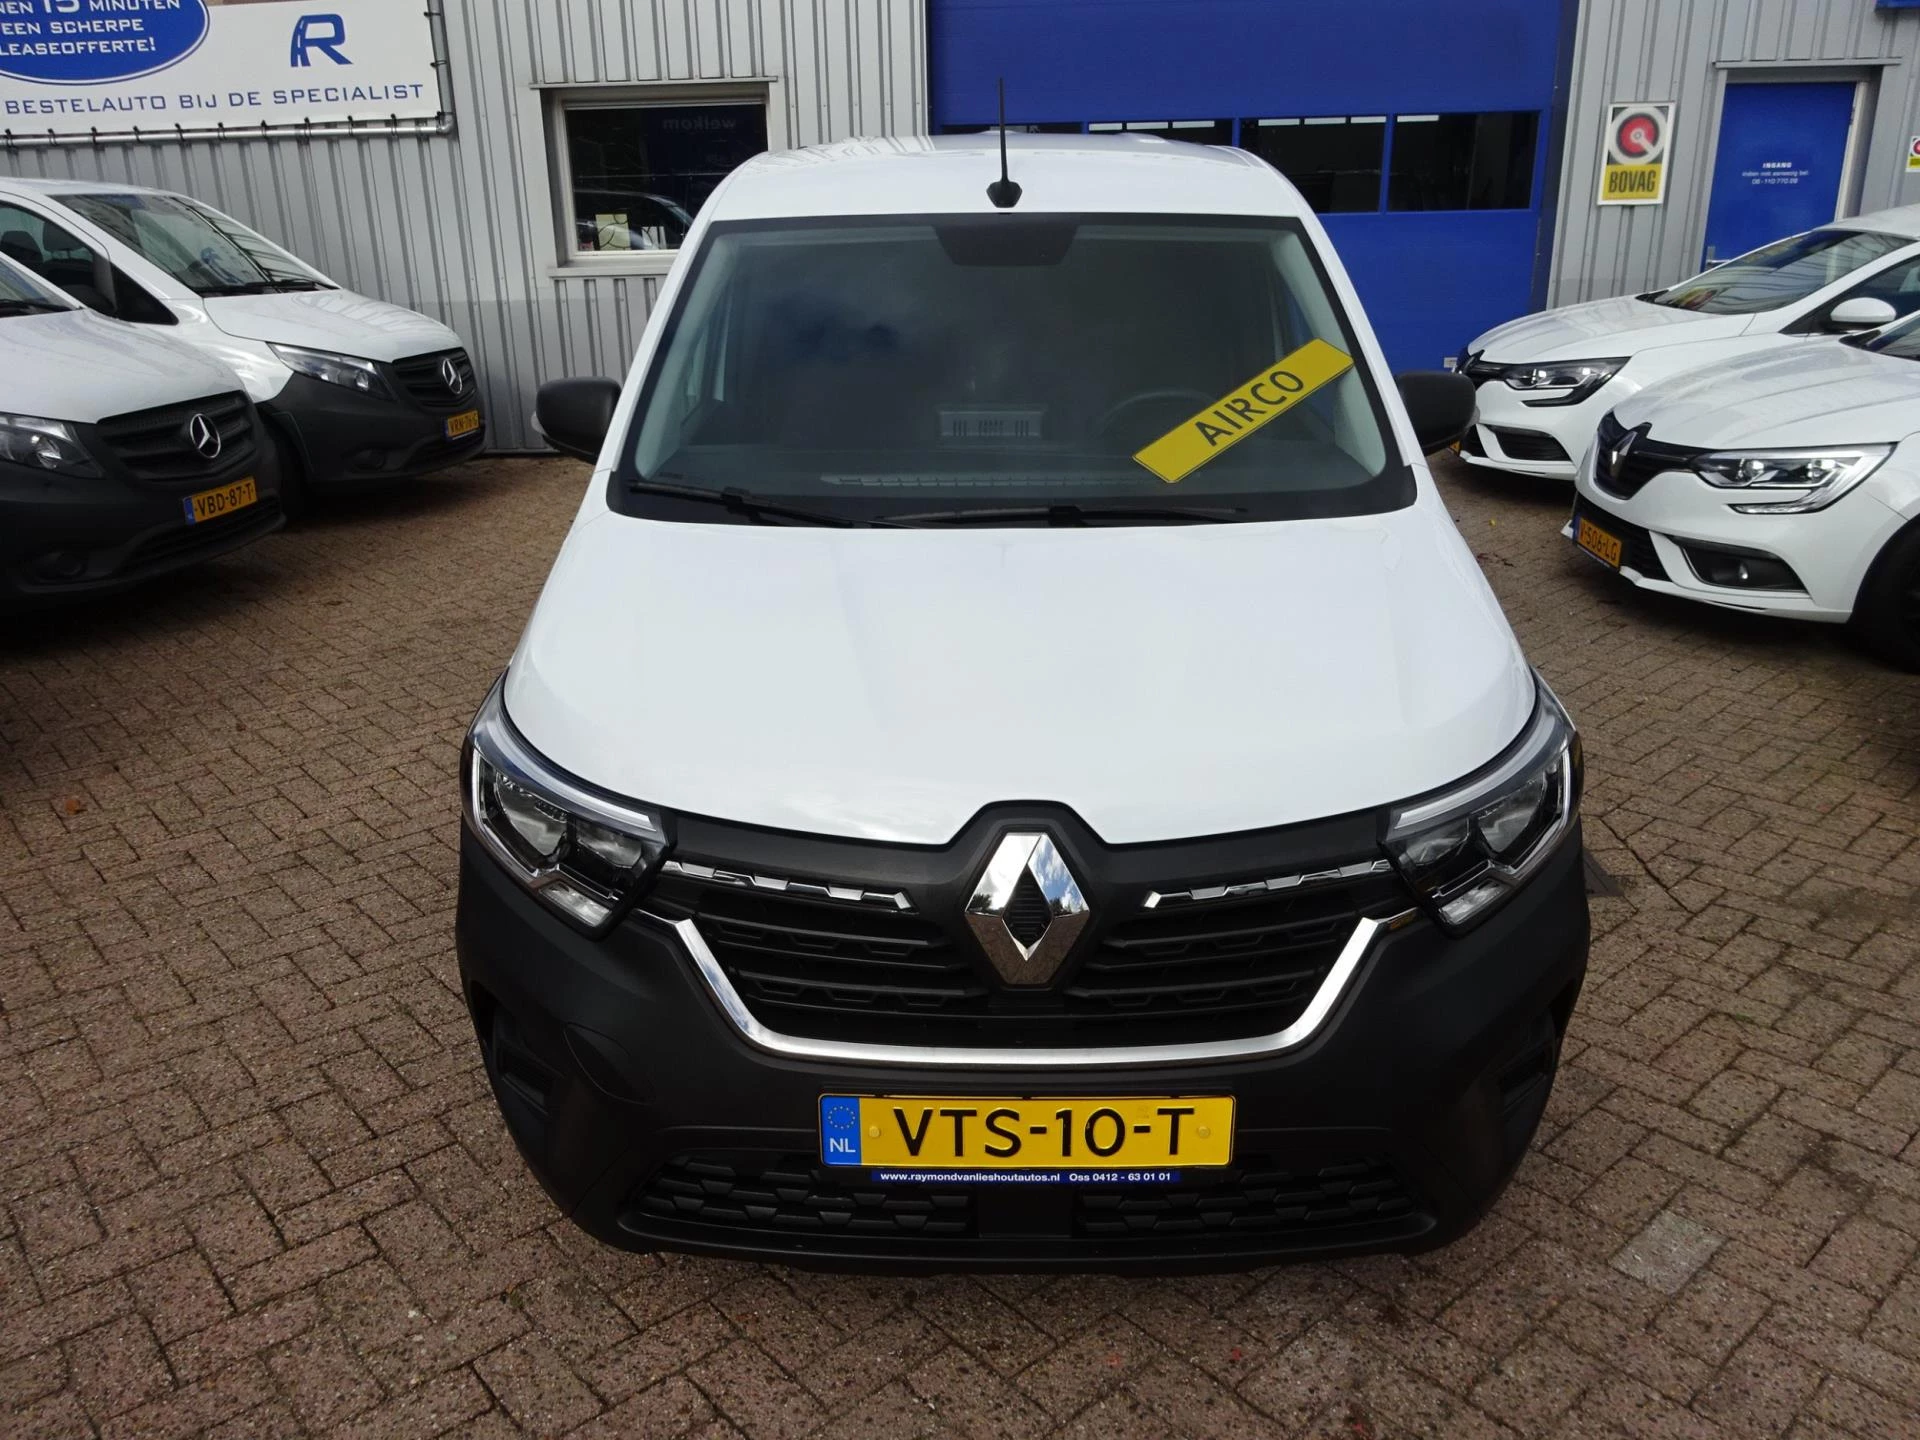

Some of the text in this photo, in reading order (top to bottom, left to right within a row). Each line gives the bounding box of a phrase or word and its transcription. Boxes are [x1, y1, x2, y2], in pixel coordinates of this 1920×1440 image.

[89, 0, 180, 12] MINUTEN
[1, 18, 144, 35] EEN SCHERPE
[0, 37, 156, 56] LEASEOFFERTE!
[5, 84, 424, 115] BESTELAUTO BIJ DE SPECIALIST
[1608, 169, 1656, 193] BOVAG
[1195, 370, 1304, 447] AIRCO
[197, 482, 252, 517] VBD-87-T
[893, 1107, 1195, 1157] VTS-10-T
[829, 1138, 856, 1153] NL
[880, 1172, 1060, 1183] www.raymondvanlieshoutautos.nl
[1069, 1172, 1090, 1182] Oss
[1092, 1172, 1118, 1182] 0412
[1128, 1172, 1143, 1181] 63
[1143, 1172, 1156, 1181] 01
[1158, 1172, 1171, 1181] 01
